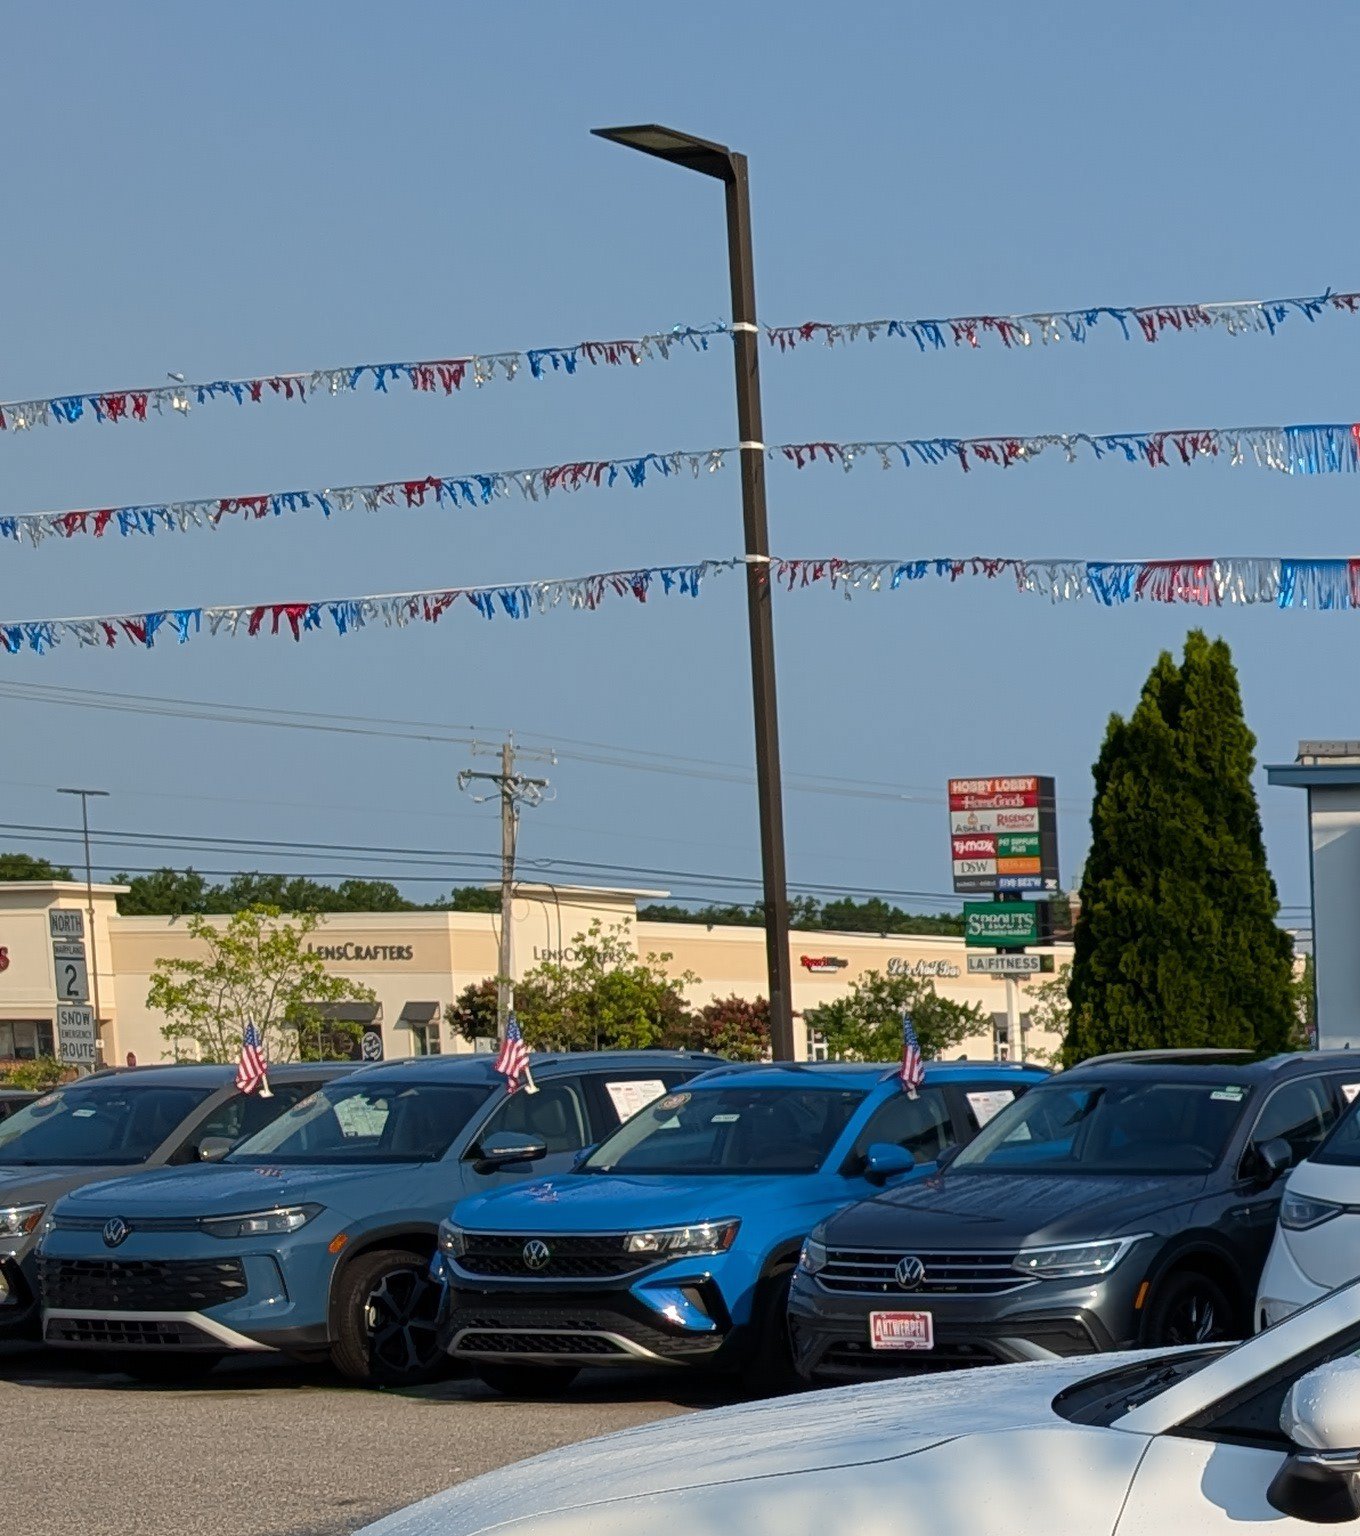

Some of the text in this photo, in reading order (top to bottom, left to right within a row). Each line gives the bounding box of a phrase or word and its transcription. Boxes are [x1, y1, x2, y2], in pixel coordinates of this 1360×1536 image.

[951, 777, 1035, 795] HOBBY LOBBY
[960, 861, 988, 873] DSW
[52, 914, 82, 932] NORTH
[968, 913, 1034, 935] SPROUTS
[969, 957, 1039, 970] LA FITNESS
[64, 964, 80, 997] 2
[61, 1011, 90, 1025] SNOW
[61, 1042, 95, 1058] ROUTE
